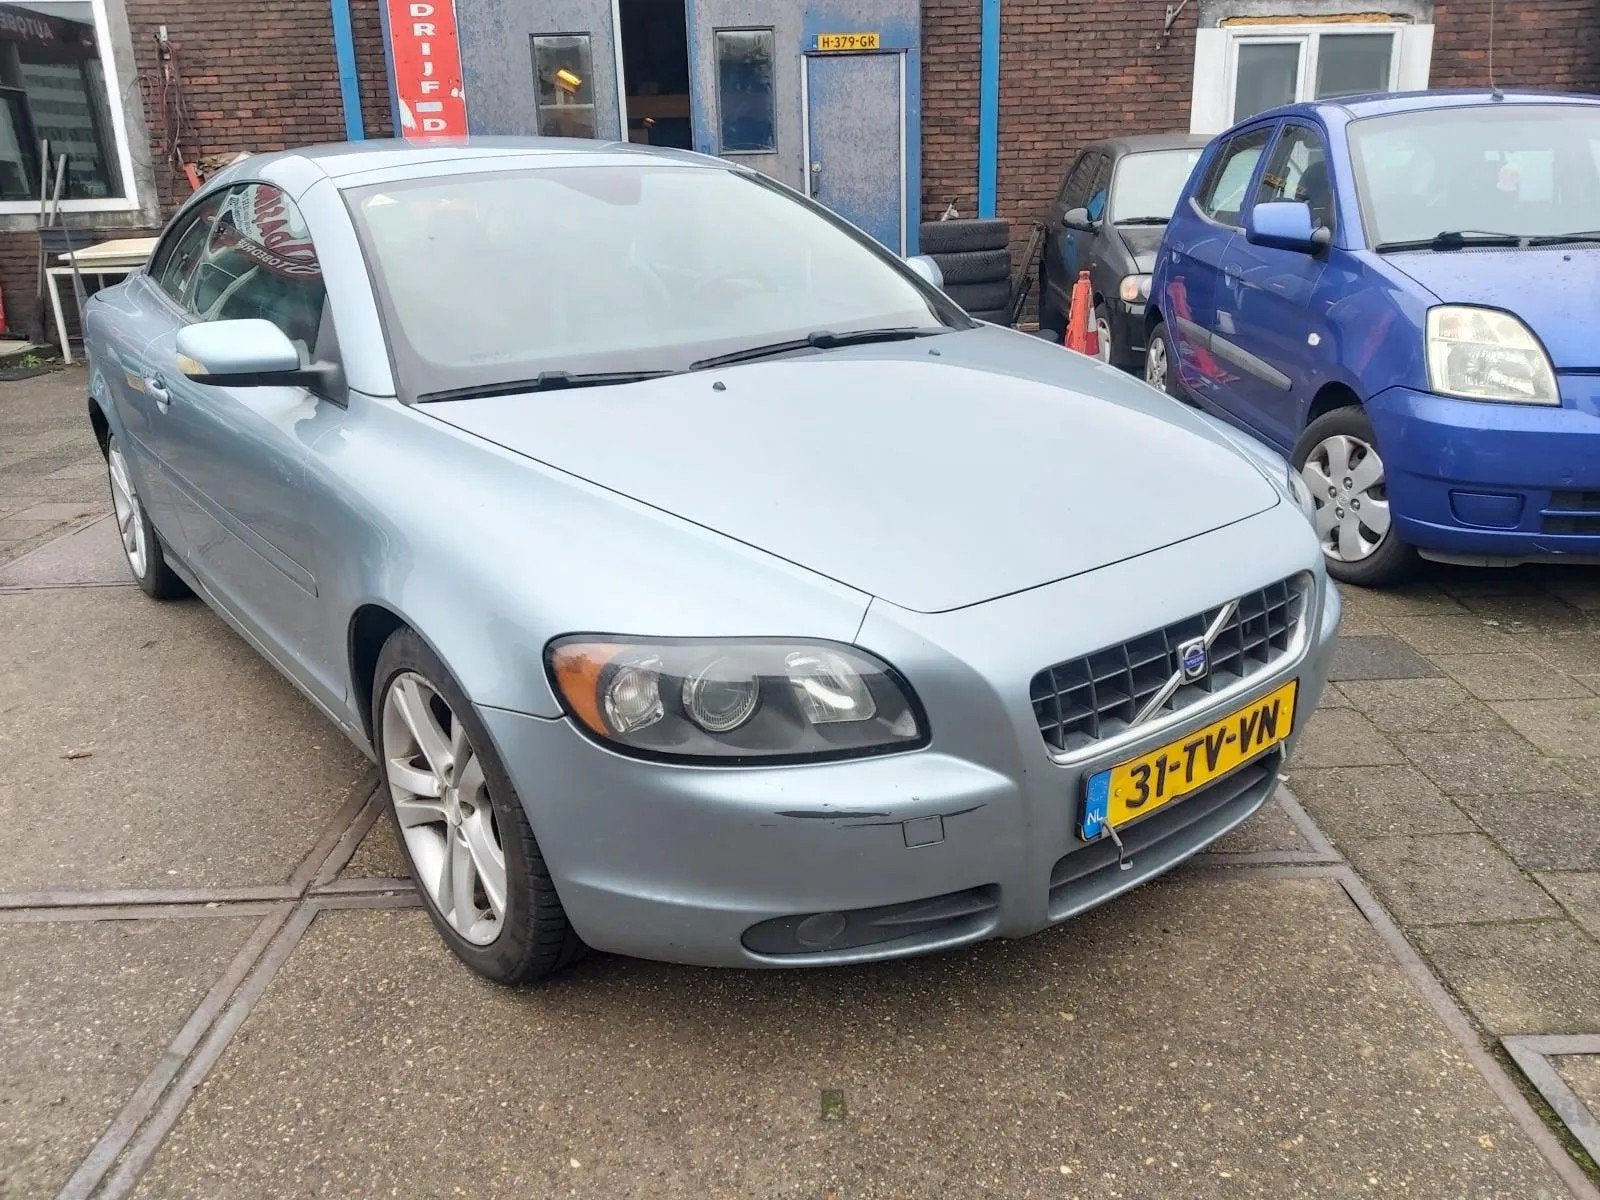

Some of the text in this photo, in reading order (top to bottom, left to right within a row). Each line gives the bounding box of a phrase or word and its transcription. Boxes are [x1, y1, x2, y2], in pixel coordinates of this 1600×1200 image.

[822, 35, 875, 48] H-379-GR
[1126, 699, 1280, 808] 31-TV-VN
[1086, 808, 1104, 826] NL
